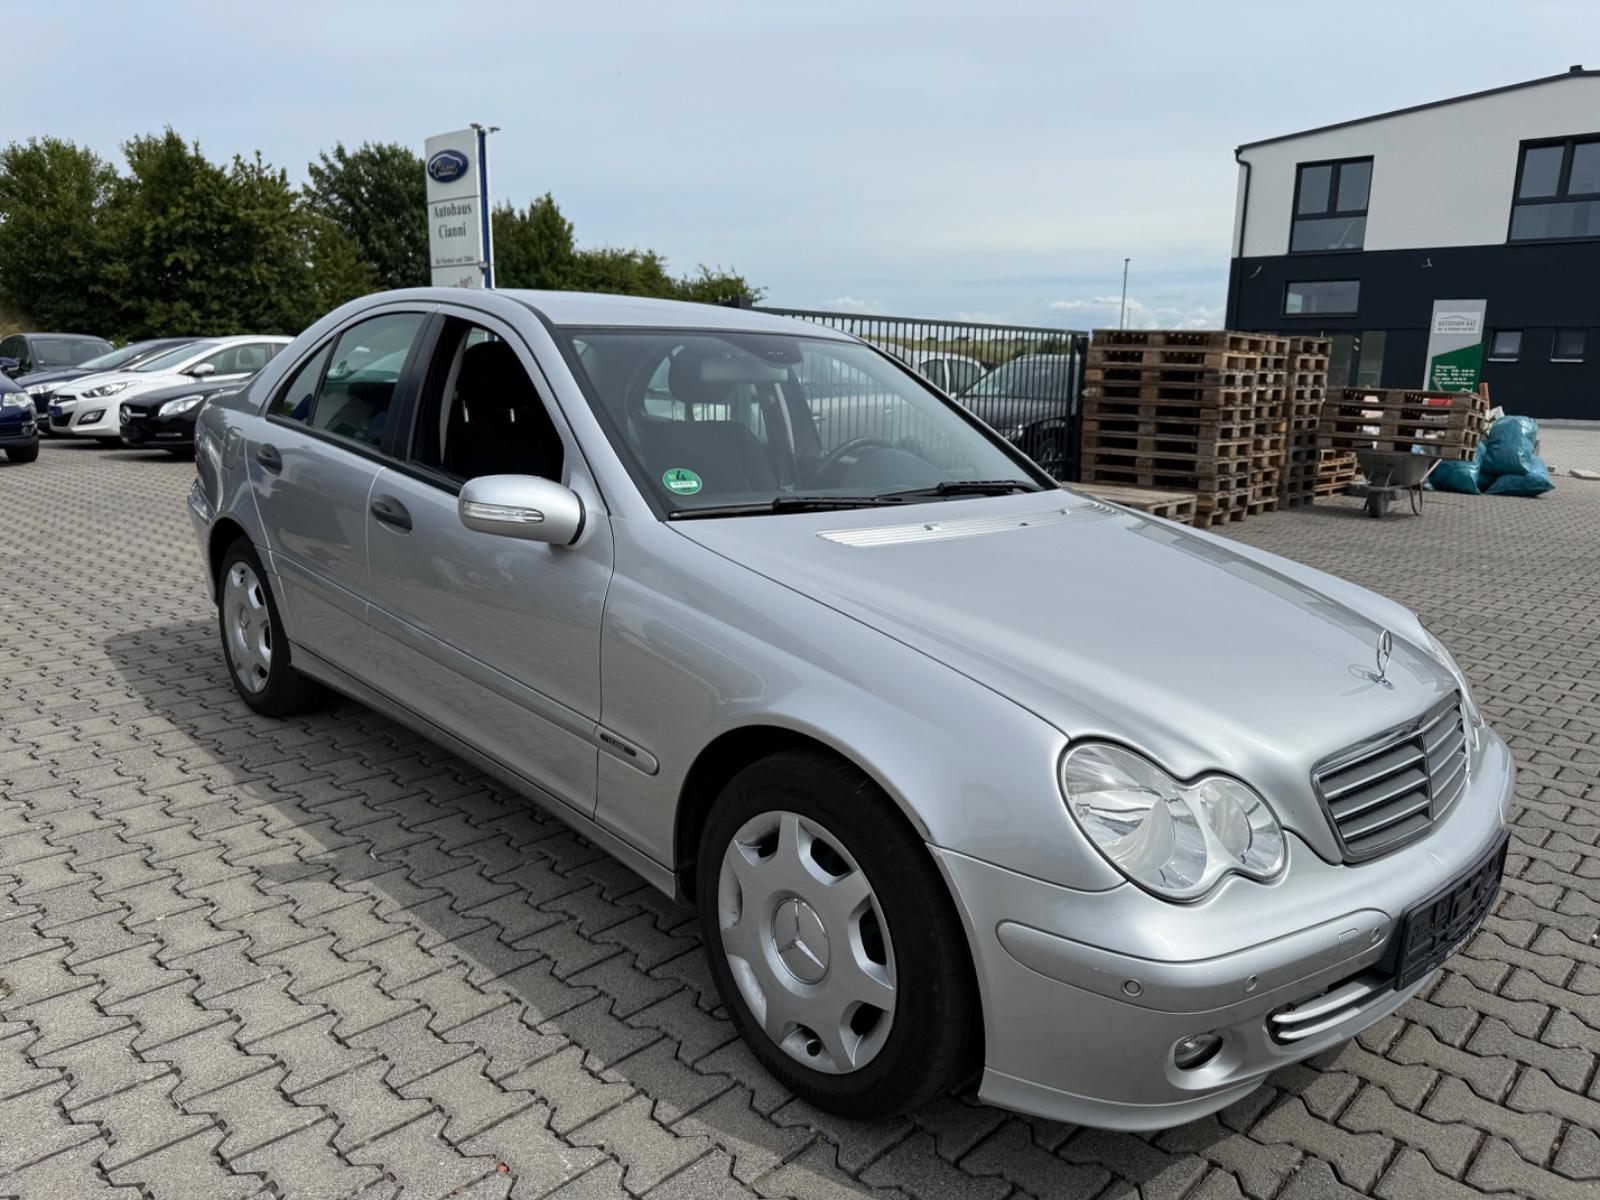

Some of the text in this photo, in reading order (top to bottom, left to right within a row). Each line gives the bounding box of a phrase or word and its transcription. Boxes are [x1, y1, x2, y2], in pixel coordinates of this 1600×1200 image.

[434, 203, 472, 218] Autohaus
[439, 222, 466, 238] Cianni
[677, 470, 687, 480] 4
